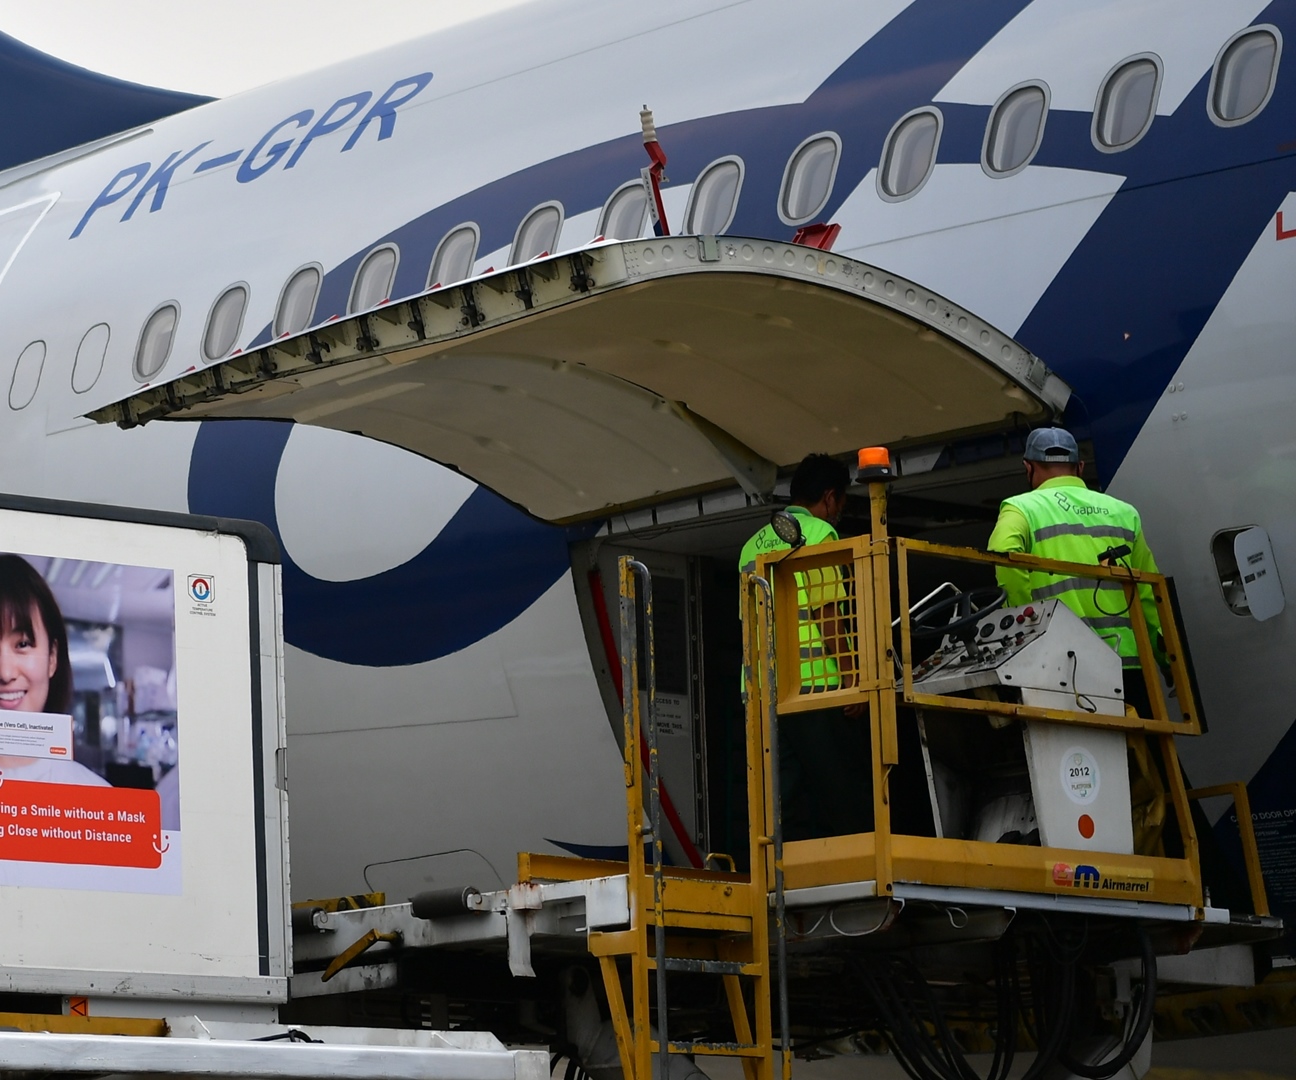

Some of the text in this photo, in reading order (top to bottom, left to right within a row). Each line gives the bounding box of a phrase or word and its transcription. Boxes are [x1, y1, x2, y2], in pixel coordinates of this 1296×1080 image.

[69, 71, 434, 240] PK-GPR
[1072, 504, 1109, 516] Gapura
[28, 723, 54, 731] Inactivated
[1069, 766, 1090, 777] 2012
[20, 804, 28, 815] a
[30, 802, 61, 818] Smile
[63, 805, 104, 821] without
[106, 810, 115, 821] a
[117, 808, 146, 824] Mask
[7, 822, 38, 839] Close
[40, 825, 82, 841] without
[85, 828, 132, 844] Distance
[1102, 878, 1150, 893] Airmarrel
